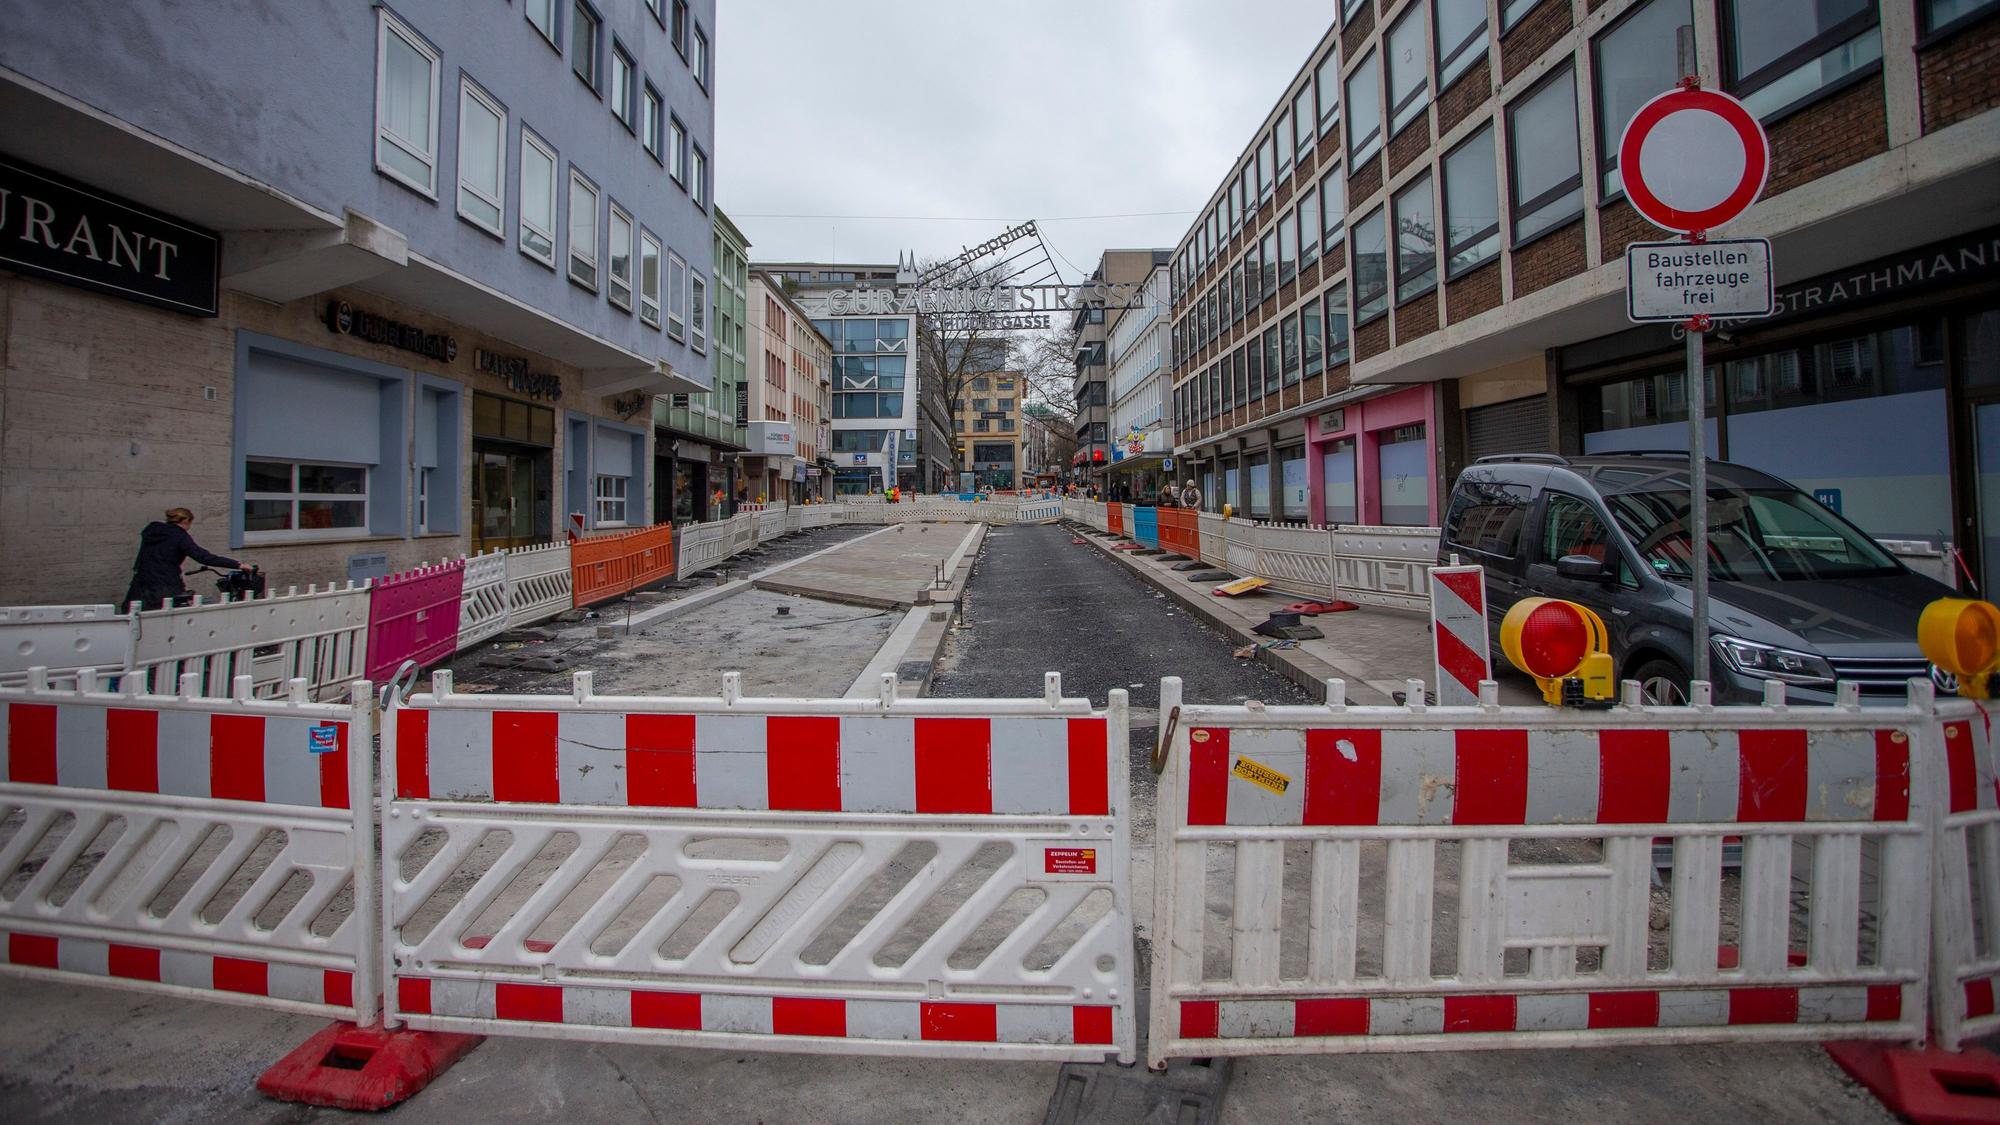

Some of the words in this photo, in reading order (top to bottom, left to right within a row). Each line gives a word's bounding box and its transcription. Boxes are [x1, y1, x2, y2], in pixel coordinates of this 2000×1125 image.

[958, 219, 1038, 265] shopping
[1648, 250, 1748, 268] Baustellen
[1656, 272, 1750, 288] fahrzeuge
[1683, 288, 1715, 304] frei
